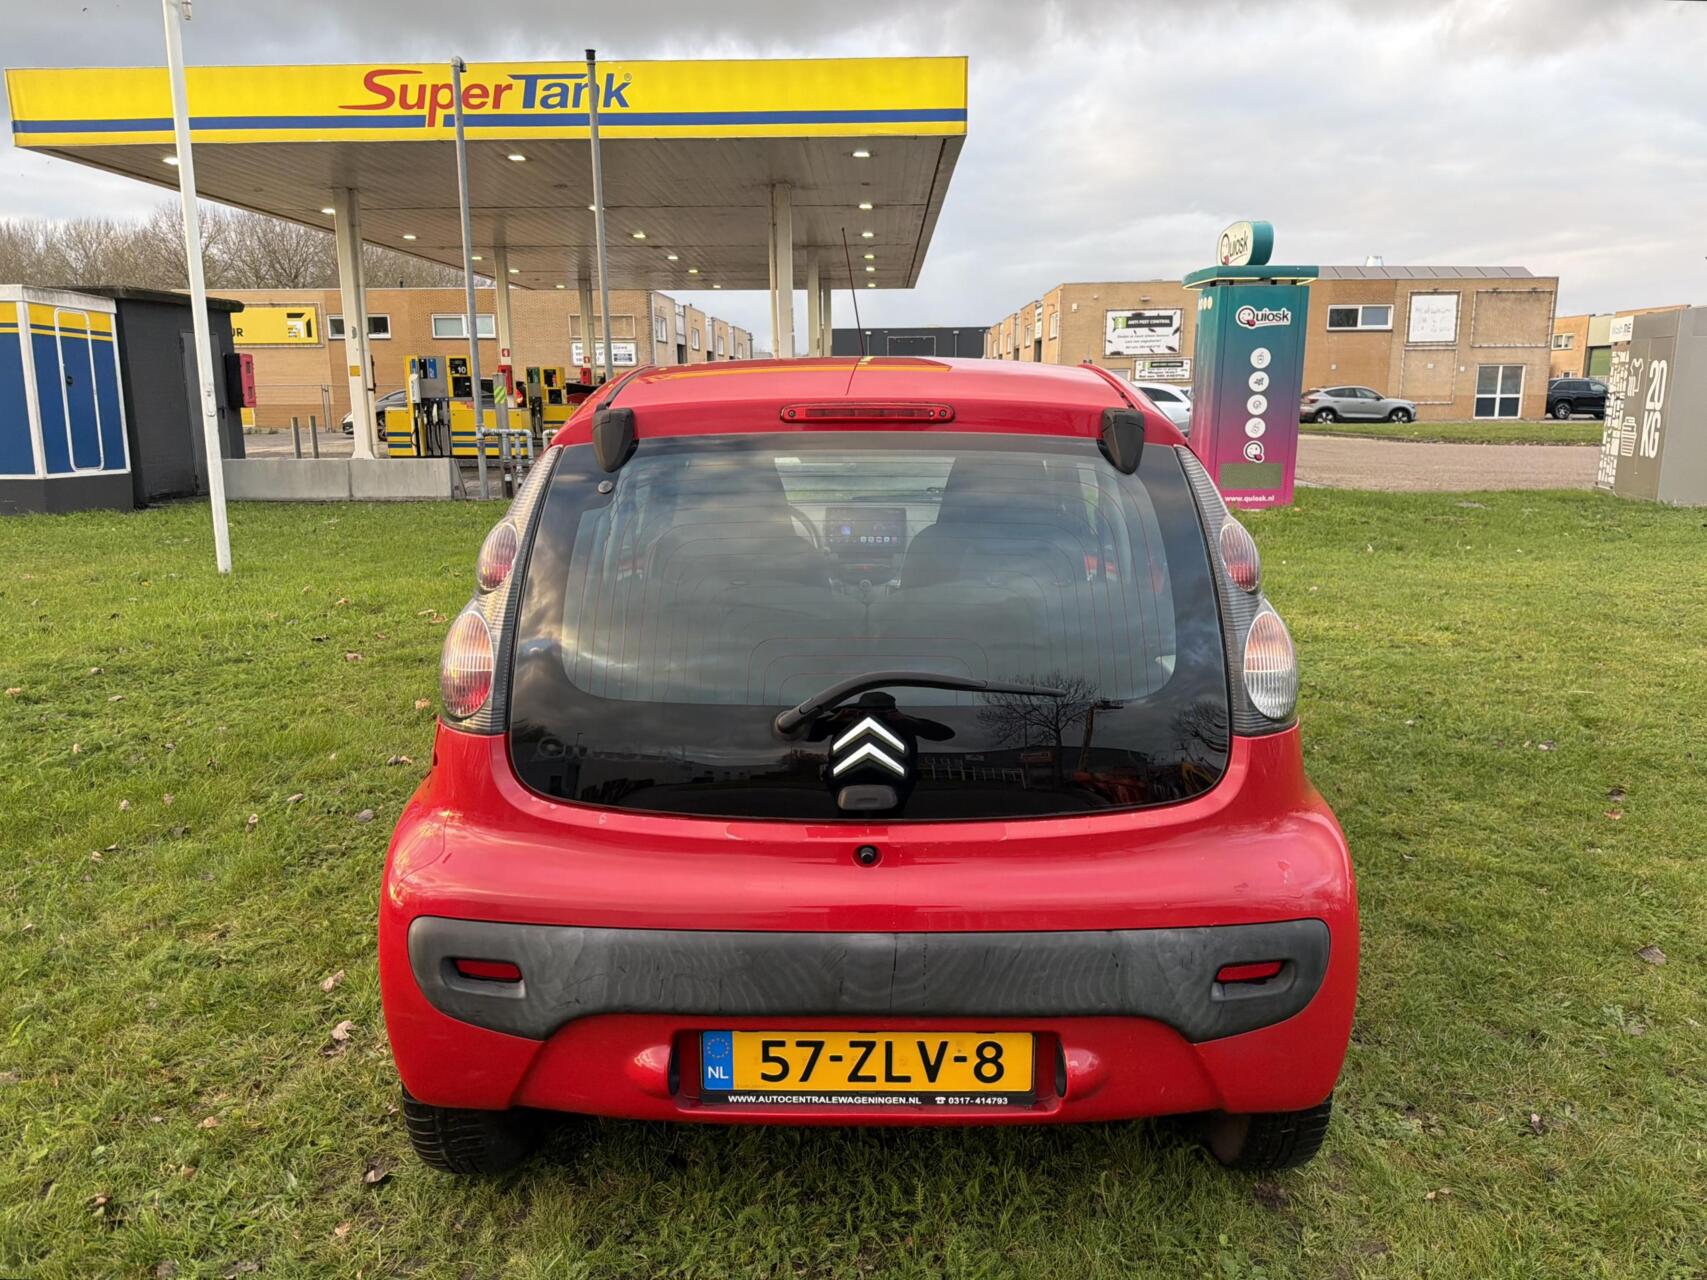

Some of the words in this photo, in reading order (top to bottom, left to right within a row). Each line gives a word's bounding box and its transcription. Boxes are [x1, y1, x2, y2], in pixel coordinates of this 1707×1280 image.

[338, 69, 632, 128] SuperTank
[1220, 230, 1249, 266] Quiosk
[1237, 306, 1290, 327] Quiosk
[1645, 359, 1668, 411] 20
[1639, 411, 1662, 459] KG
[1224, 495, 1275, 503] www.quiosk.nl
[707, 1066, 729, 1080] NL
[760, 1040, 1005, 1084] 57-ZLV-8
[728, 1095, 922, 1105] WWW.AUTOCENTRALEWAGENINGEN.NL
